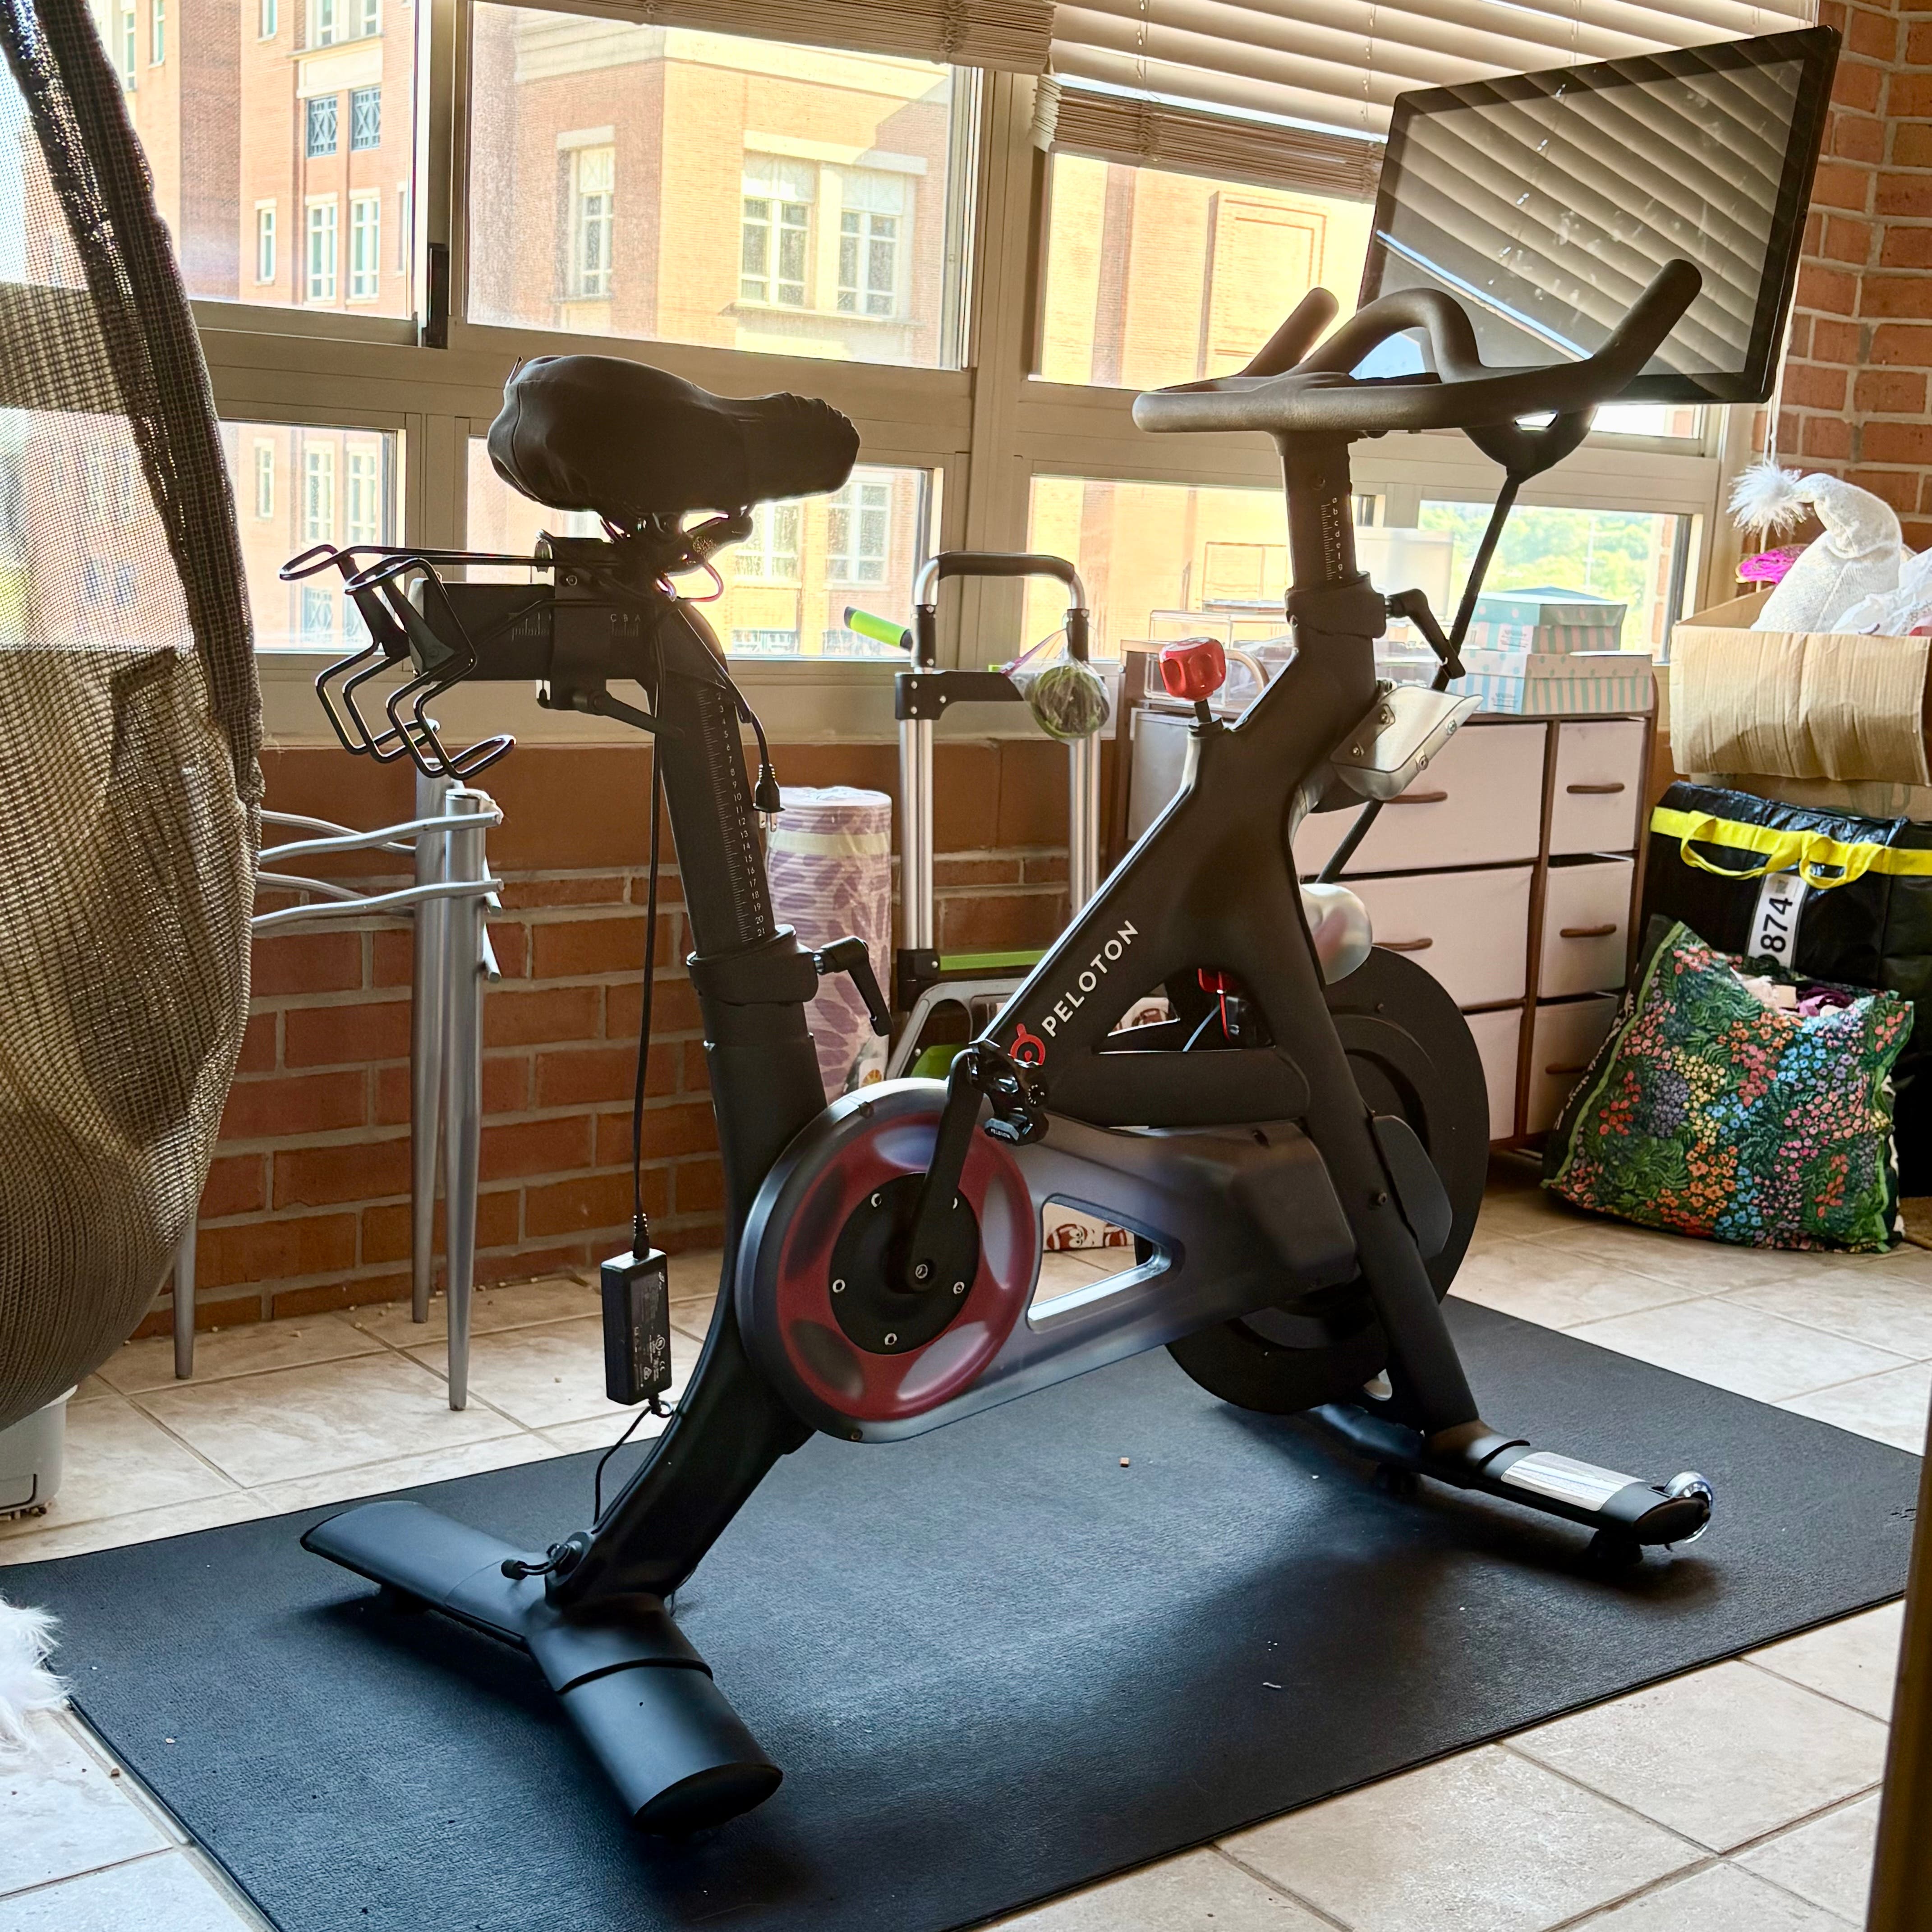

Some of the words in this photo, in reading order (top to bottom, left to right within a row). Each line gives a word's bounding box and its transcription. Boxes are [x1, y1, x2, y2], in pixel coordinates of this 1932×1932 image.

[610, 614, 616, 622] C
[730, 768, 736, 776] 8
[732, 781, 737, 789] 9
[734, 792, 742, 801] 10
[736, 805, 743, 813] 11
[738, 818, 745, 826] 12
[743, 842, 750, 850] 14
[745, 854, 753, 863] 15
[747, 867, 755, 875] 16
[750, 879, 756, 888] 17
[752, 891, 759, 900] 18
[754, 902, 761, 912] 19
[755, 915, 764, 924] 20
[1760, 897, 1793, 953] 874
[757, 928, 765, 937] 21
[1041, 920, 1138, 1037] PELOTON
